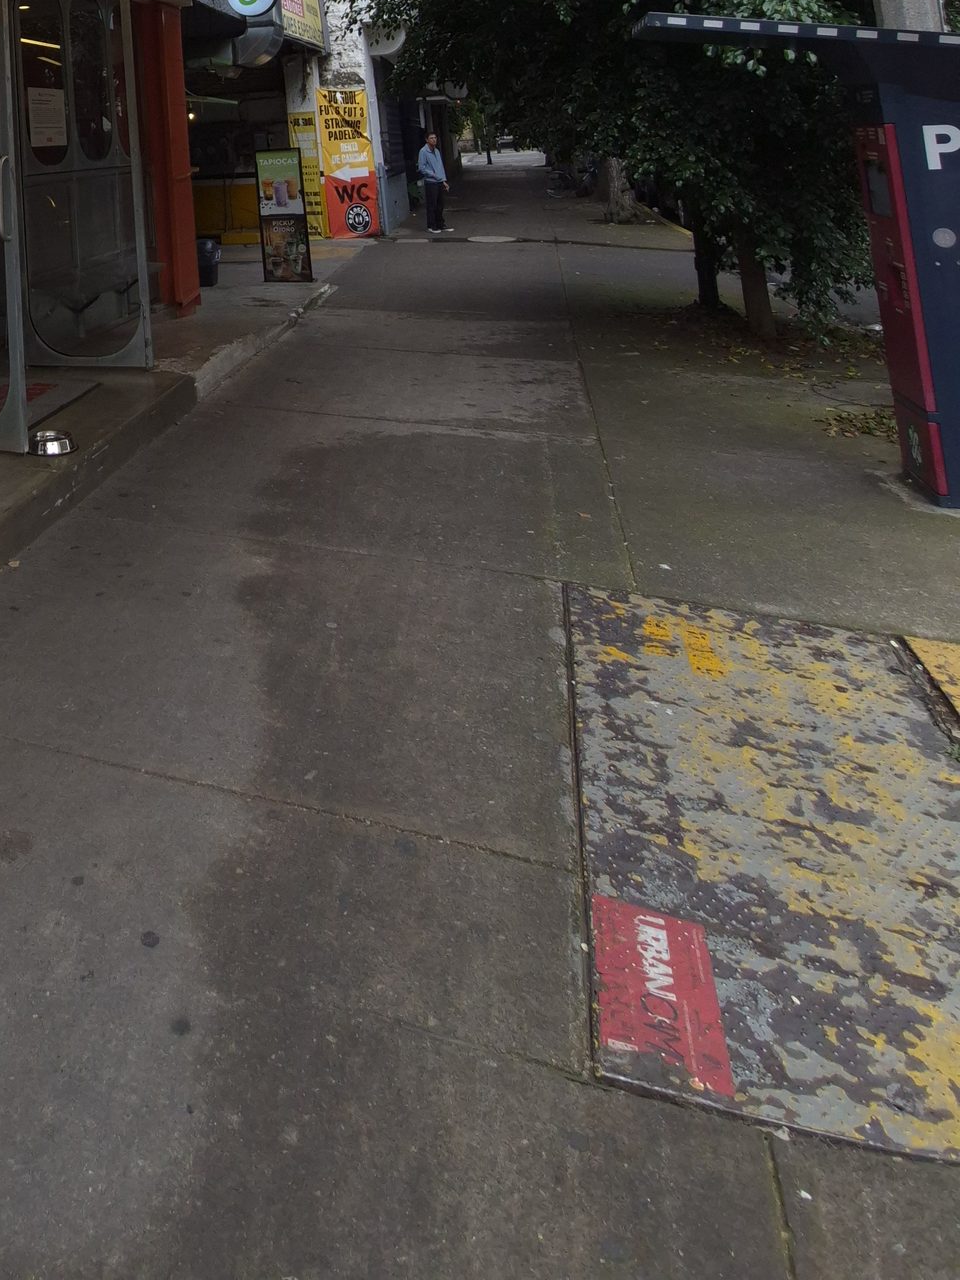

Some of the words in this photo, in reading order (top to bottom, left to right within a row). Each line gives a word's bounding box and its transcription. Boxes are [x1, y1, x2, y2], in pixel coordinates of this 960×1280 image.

[343, 107, 357, 117] FUT
[259, 157, 298, 167] TAPIOCAS
[335, 183, 370, 204] WC
